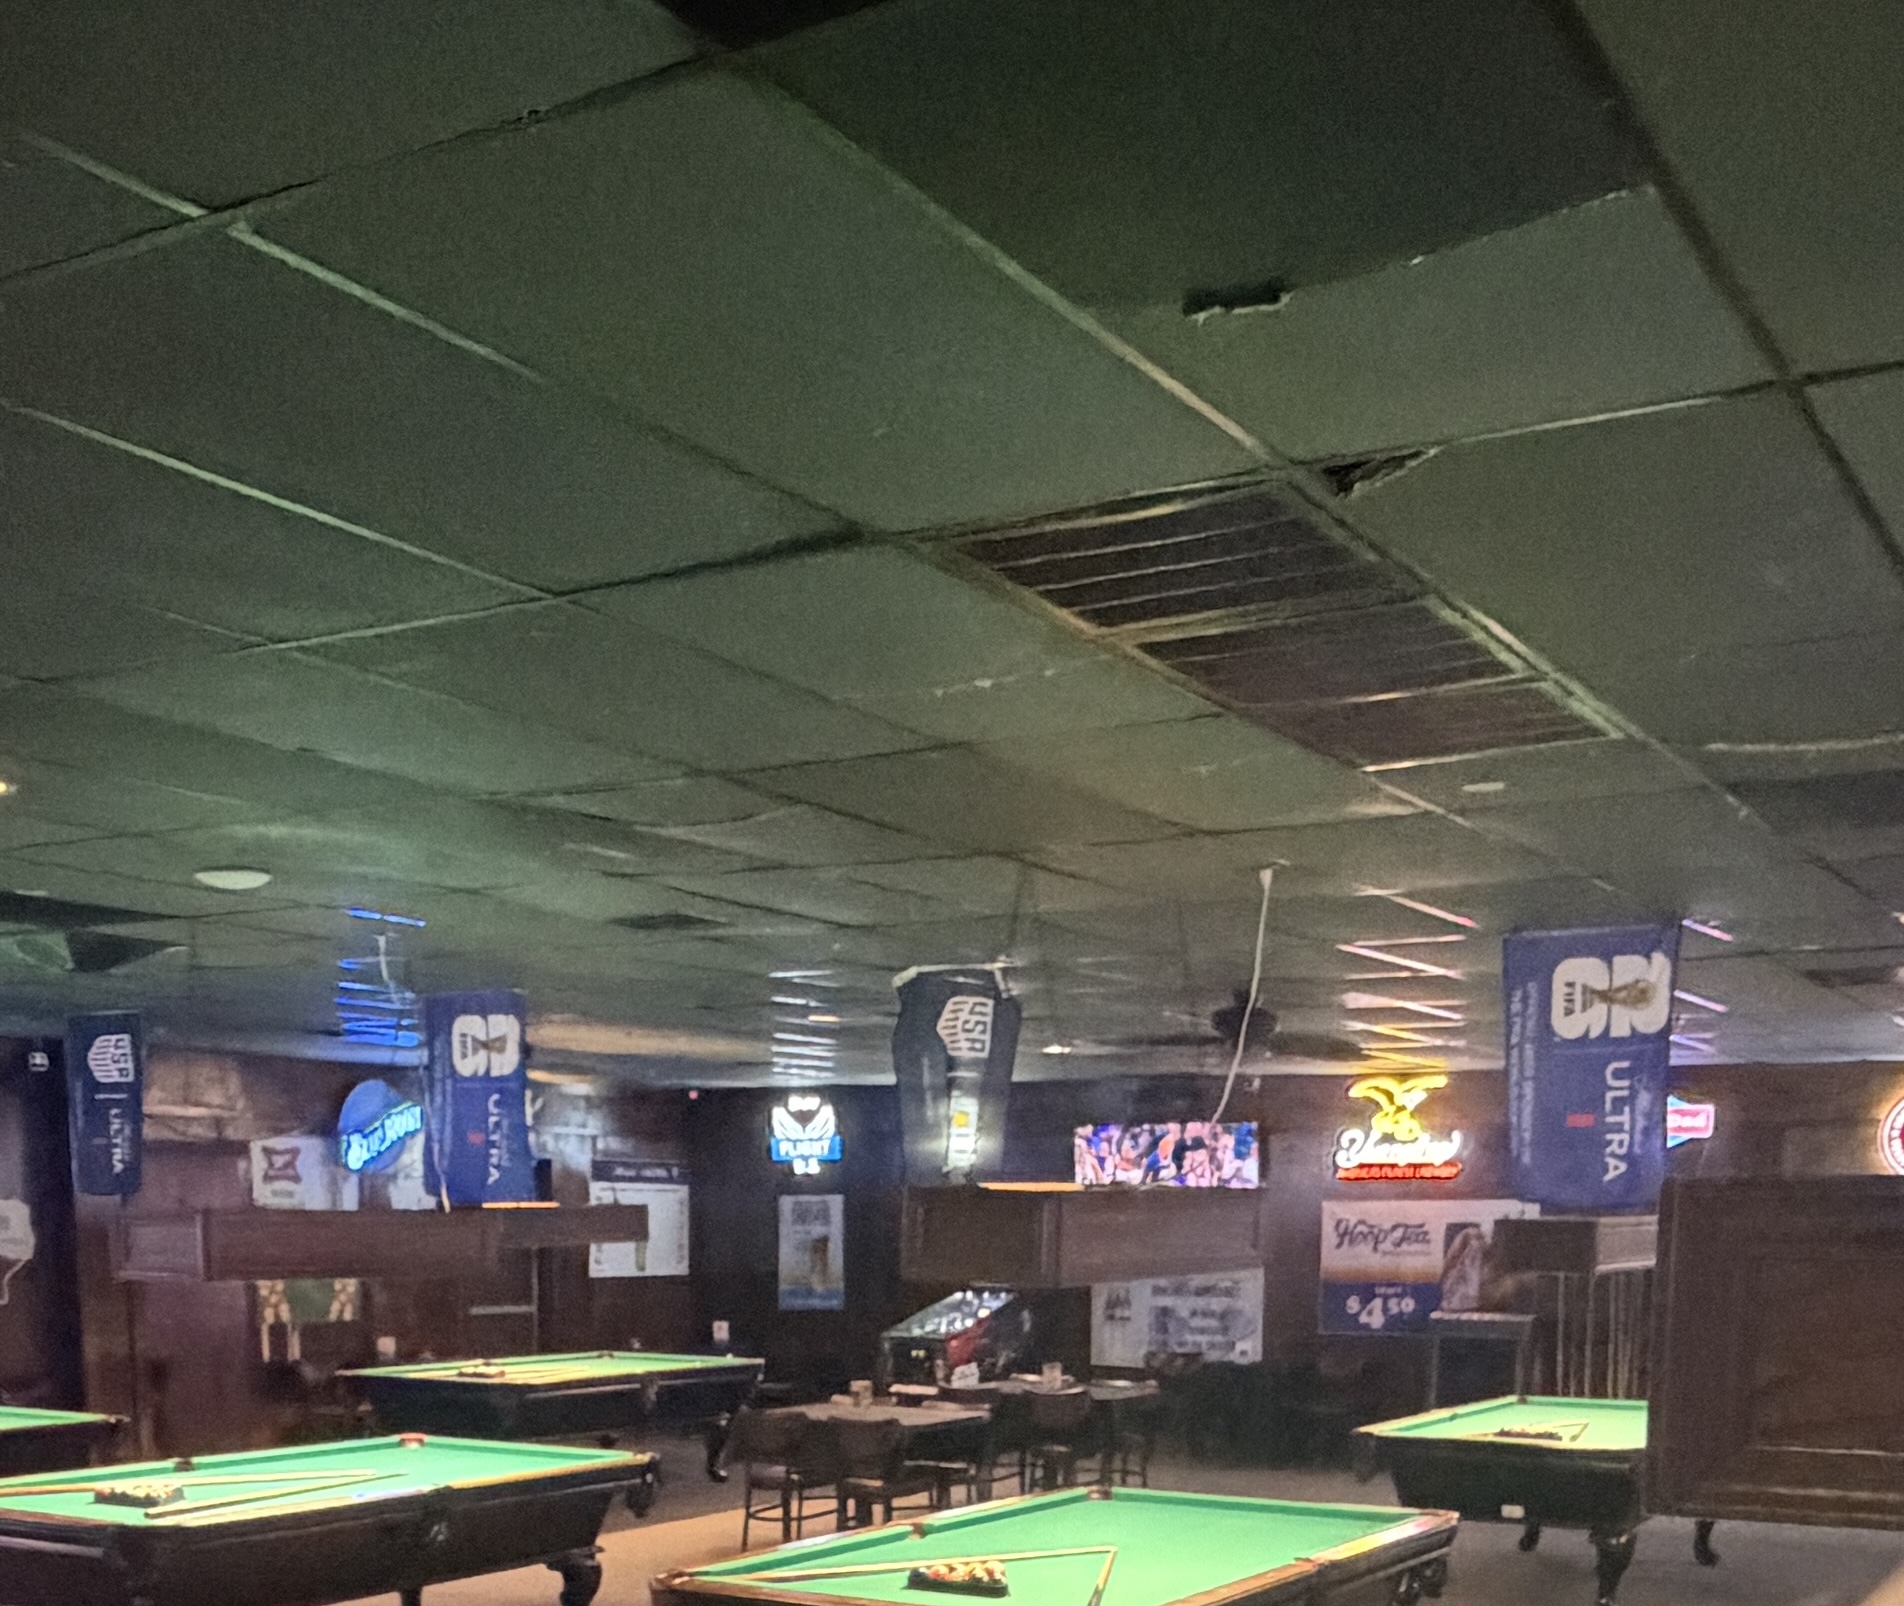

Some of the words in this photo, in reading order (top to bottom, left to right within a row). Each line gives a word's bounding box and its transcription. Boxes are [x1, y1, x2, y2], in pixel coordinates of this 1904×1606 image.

[962, 1001, 990, 1053] USA
[1563, 981, 1576, 1018] FIFA
[109, 1108, 124, 1174] ULTRA
[487, 1093, 502, 1185] ULTRA
[1603, 1061, 1632, 1182] ULTRA
